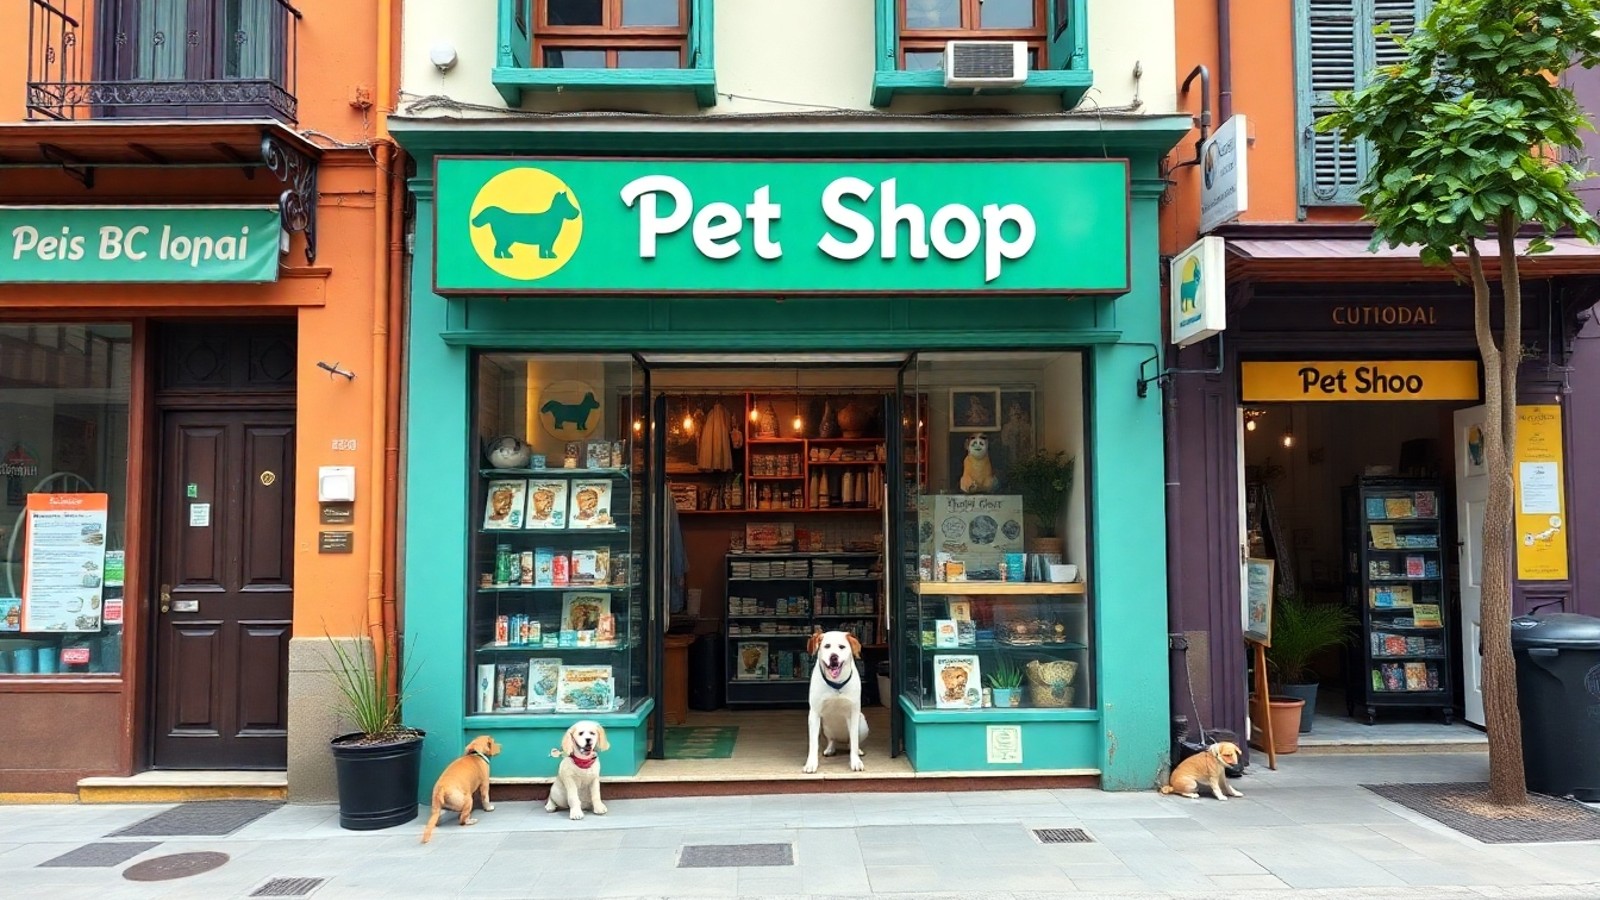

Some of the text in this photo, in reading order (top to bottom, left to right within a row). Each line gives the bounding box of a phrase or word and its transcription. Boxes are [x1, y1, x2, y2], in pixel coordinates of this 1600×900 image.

[12, 225, 85, 261] Peis
[98, 225, 150, 261] BC
[619, 173, 1037, 283] Pet Shop
[1298, 366, 1424, 394] Pet Shoo
